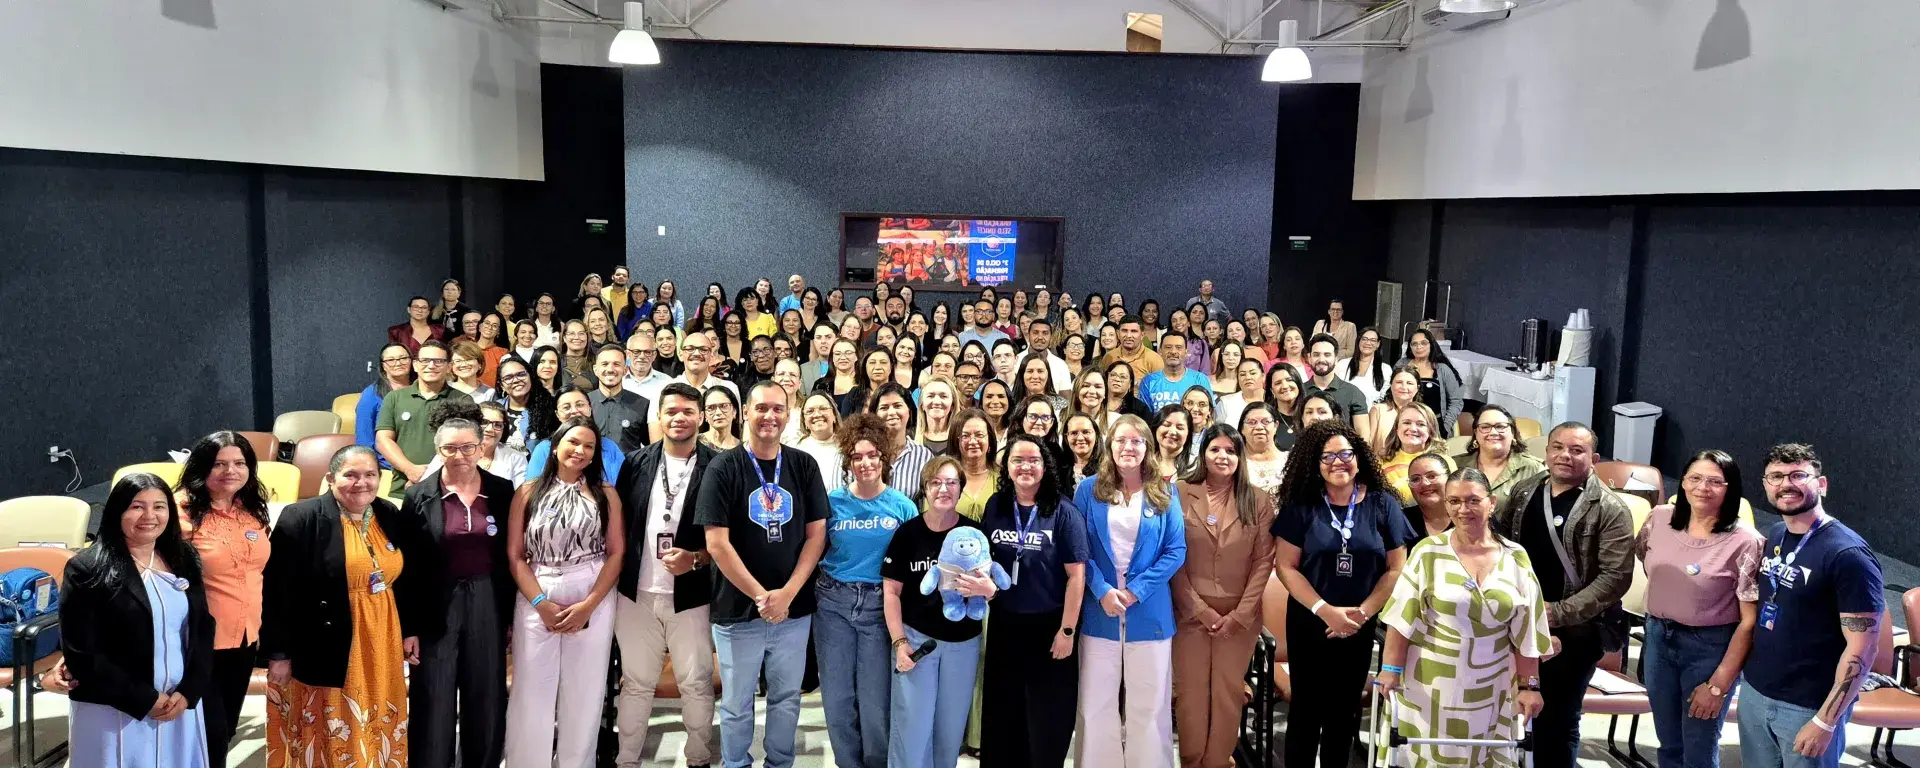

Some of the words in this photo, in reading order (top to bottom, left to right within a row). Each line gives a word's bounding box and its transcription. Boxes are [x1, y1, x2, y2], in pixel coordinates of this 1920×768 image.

[834, 516, 879, 531] unicef
[991, 529, 1044, 545] ASSTE
[910, 557, 938, 572] unic
